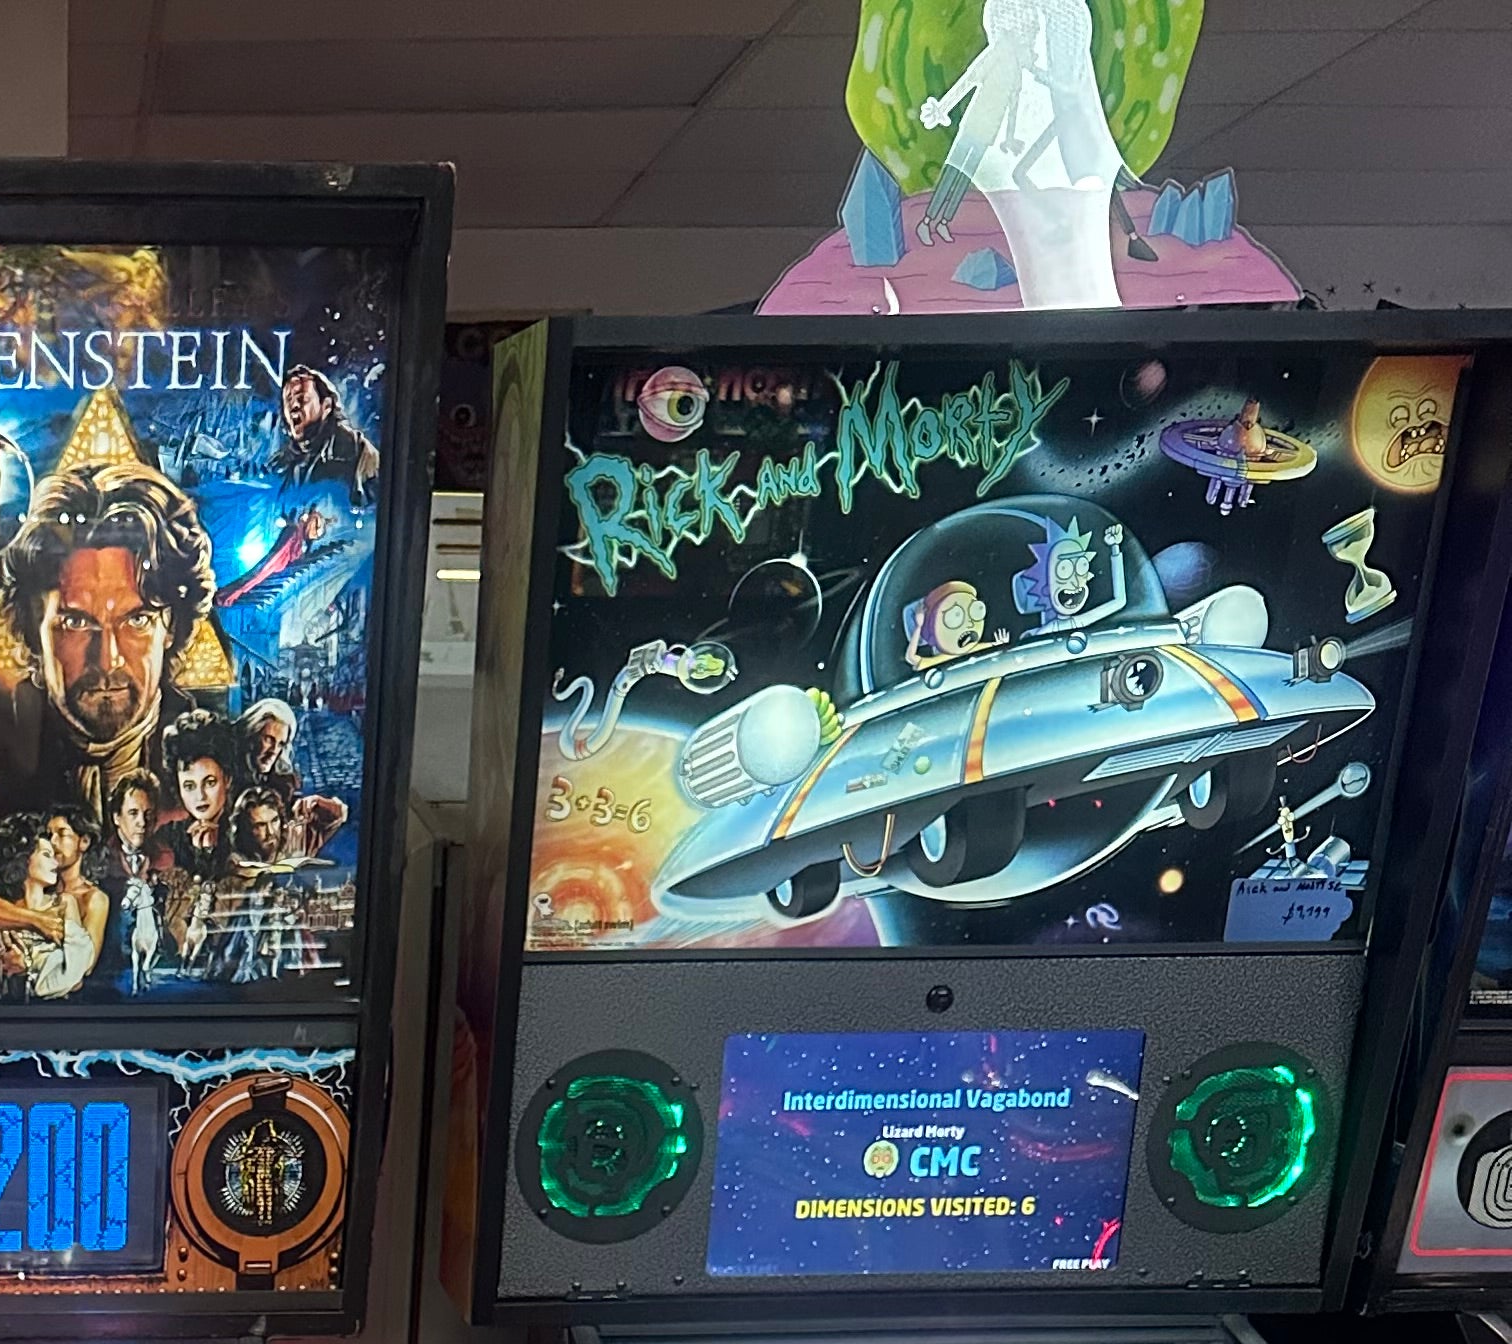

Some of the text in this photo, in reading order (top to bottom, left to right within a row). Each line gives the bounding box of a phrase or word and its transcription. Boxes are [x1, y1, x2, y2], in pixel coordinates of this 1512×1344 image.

[783, 1088, 1070, 1113] Interdimensional Vagabond
[882, 1124, 965, 1141] Lizard Morty
[909, 1145, 982, 1178] CMC
[795, 1196, 1036, 1219] DIMENSIONS VISITED: 6
[1052, 1258, 1111, 1271] FREE PLAY
